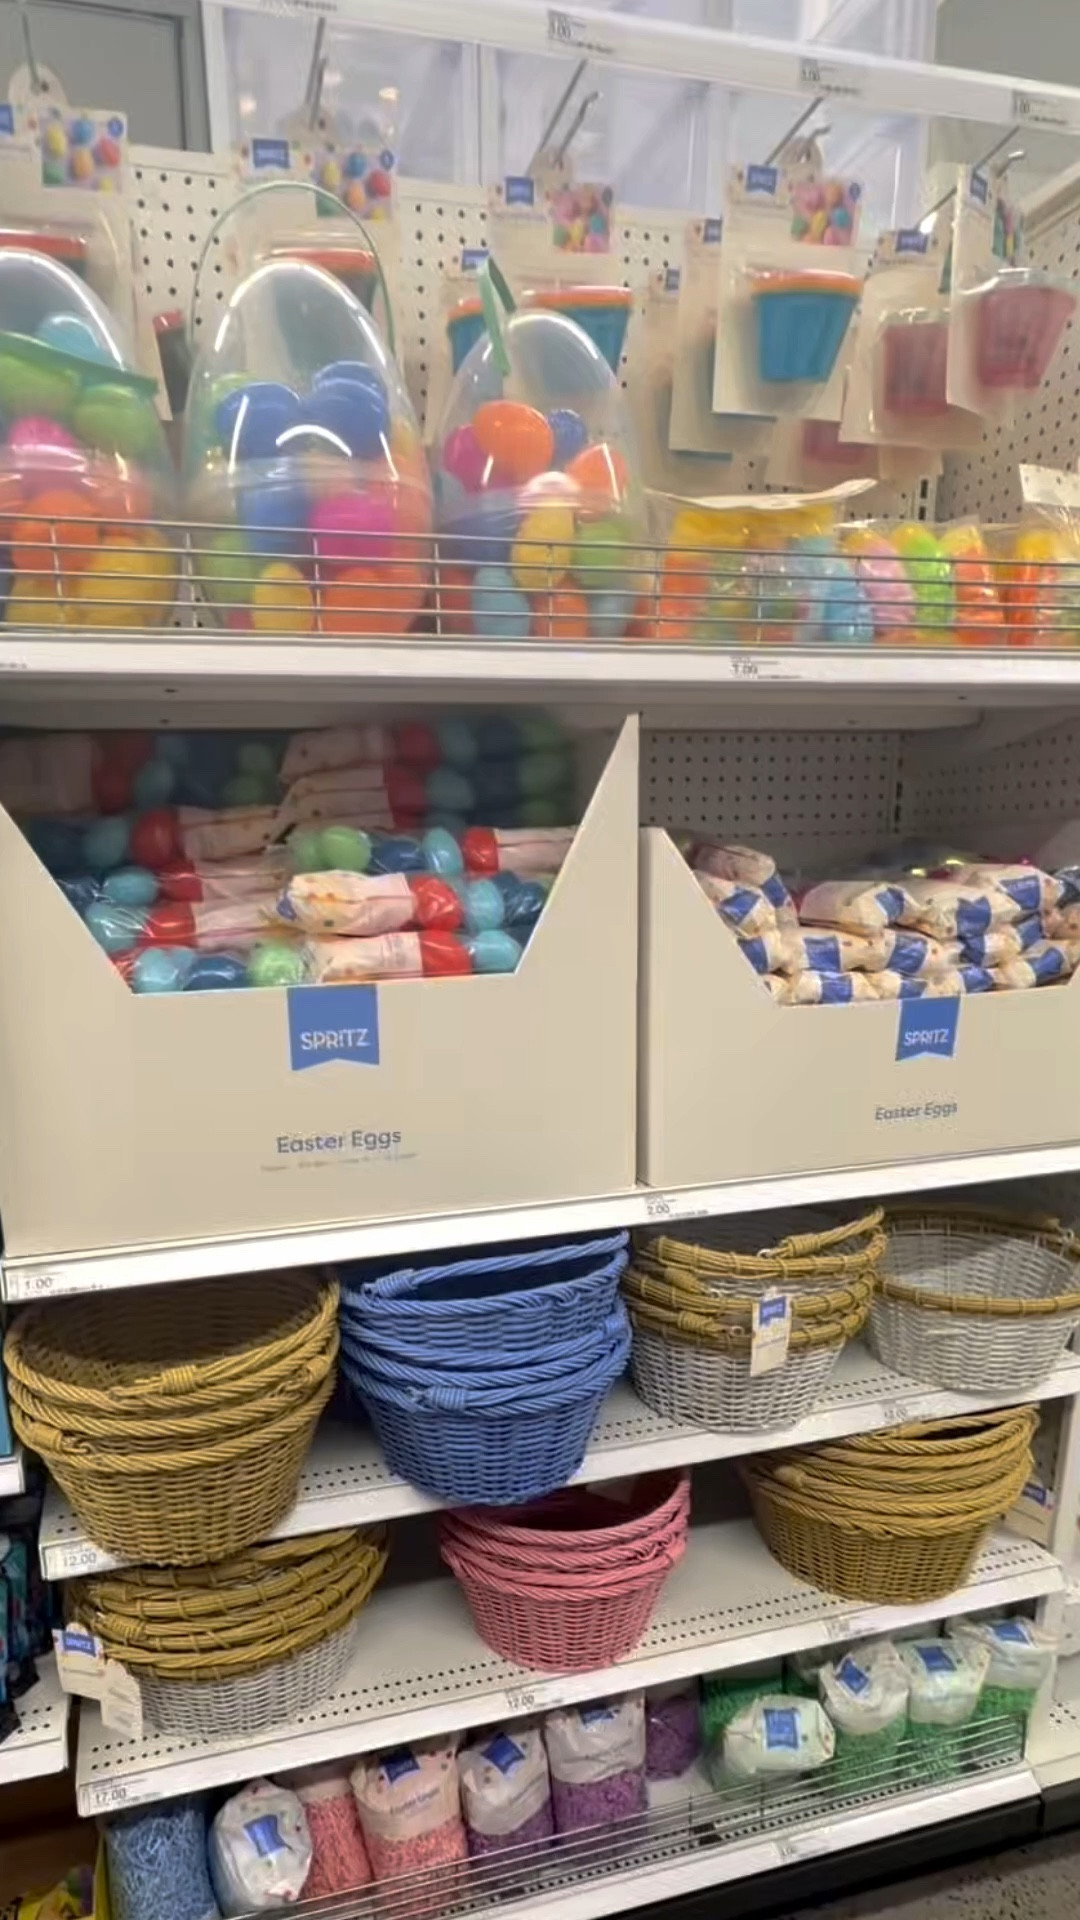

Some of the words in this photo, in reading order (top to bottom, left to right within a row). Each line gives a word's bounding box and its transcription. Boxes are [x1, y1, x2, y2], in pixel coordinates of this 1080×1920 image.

[300, 1028, 371, 1050] SPRITZ
[903, 1028, 949, 1047] SPRITZ
[875, 1107, 921, 1120] Easter
[924, 1102, 957, 1118] Eggs
[275, 1135, 345, 1153] Easter
[351, 1131, 402, 1150] Eggs
[24, 1277, 54, 1290] 1.00
[63, 1551, 98, 1568] 12.00
